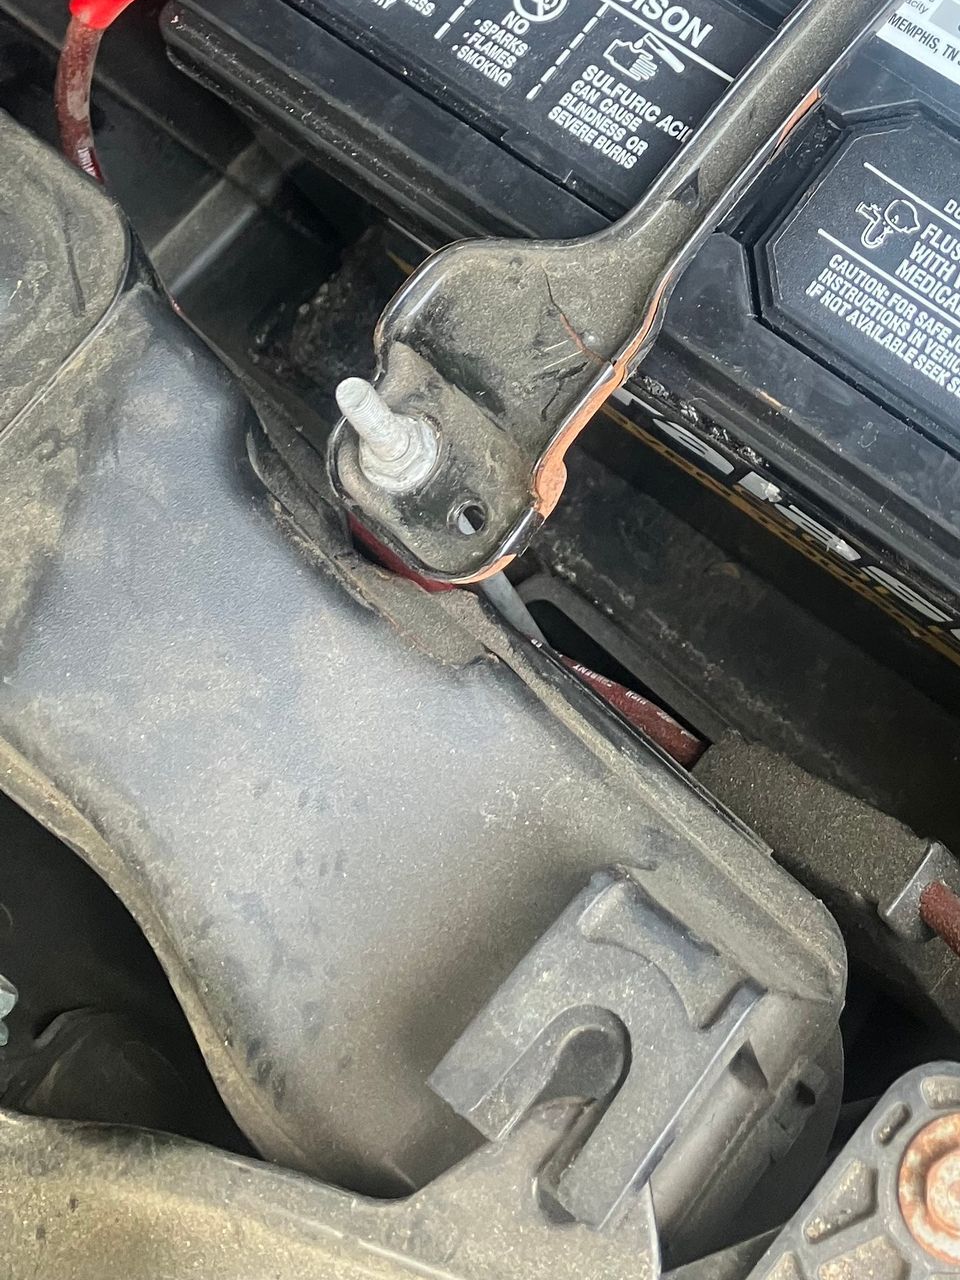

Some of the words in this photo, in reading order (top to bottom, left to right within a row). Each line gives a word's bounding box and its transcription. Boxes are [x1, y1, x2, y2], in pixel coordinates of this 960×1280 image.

[466, 30, 517, 70] FLAMES
[477, 18, 529, 57] SPARKS
[500, 9, 530, 36] NO
[886, 9, 941, 54] MEMPHIS,
[941, 43, 960, 63] TN
[455, 44, 513, 88] SMOKING
[557, 91, 627, 142] BLINDNESS
[624, 134, 649, 157] OR
[569, 78, 601, 105] CAN
[597, 97, 643, 133] CAUSE
[580, 63, 662, 123] SULFURIC
[654, 113, 694, 143] ACI
[546, 104, 599, 146] SEVERE
[591, 133, 638, 170] BURNS
[908, 240, 957, 283] WITH
[813, 267, 911, 338] INSTRUCTIONS
[905, 327, 928, 349] IN
[827, 252, 891, 304] CAUTION:
[885, 291, 918, 321] FOR
[913, 310, 953, 344] SAFE
[804, 279, 825, 299] IF
[818, 288, 852, 317] NOT
[844, 308, 919, 365] AVAILABLE
[911, 352, 952, 387] SEEK
